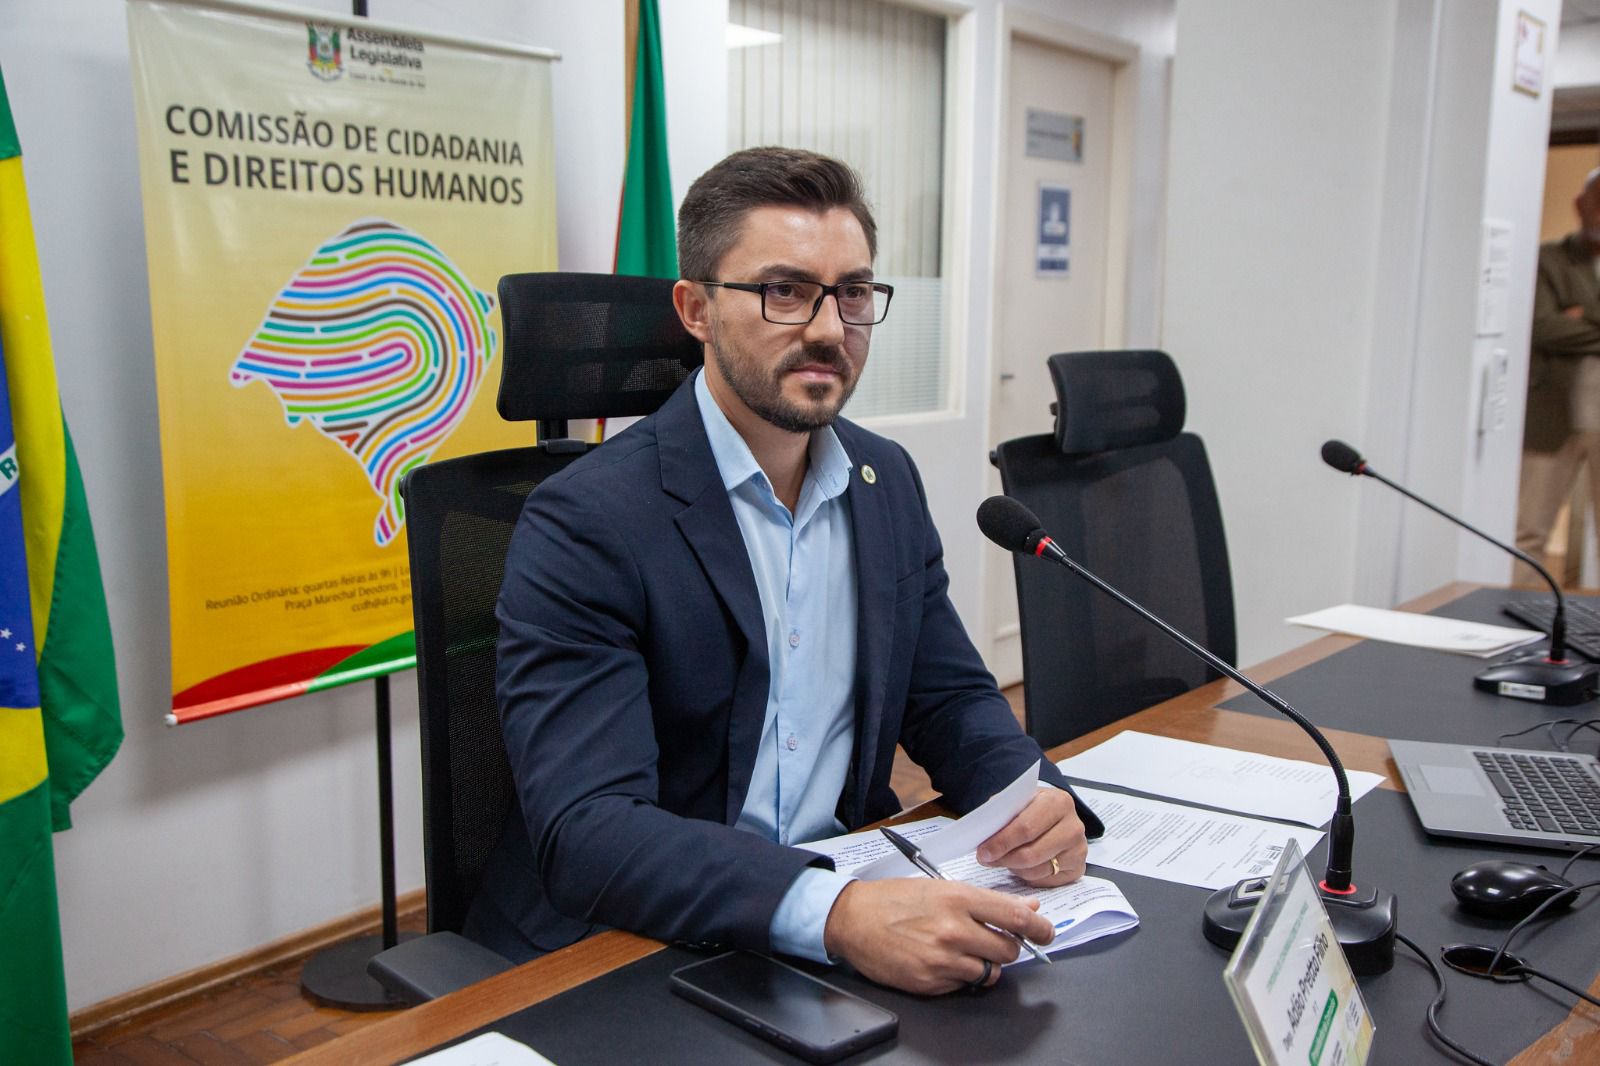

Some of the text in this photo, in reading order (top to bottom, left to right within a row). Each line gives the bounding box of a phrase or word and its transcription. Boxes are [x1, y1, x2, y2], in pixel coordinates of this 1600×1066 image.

[346, 27, 424, 52] Assembleia
[349, 46, 422, 69] Legislativa
[165, 104, 523, 166] COMISSÃO DE CIDADANIA
[170, 149, 523, 205] E DIREITOS HUMANOS
[1287, 991, 1306, 1034] Adão
[1298, 955, 1320, 1002] Pretto
